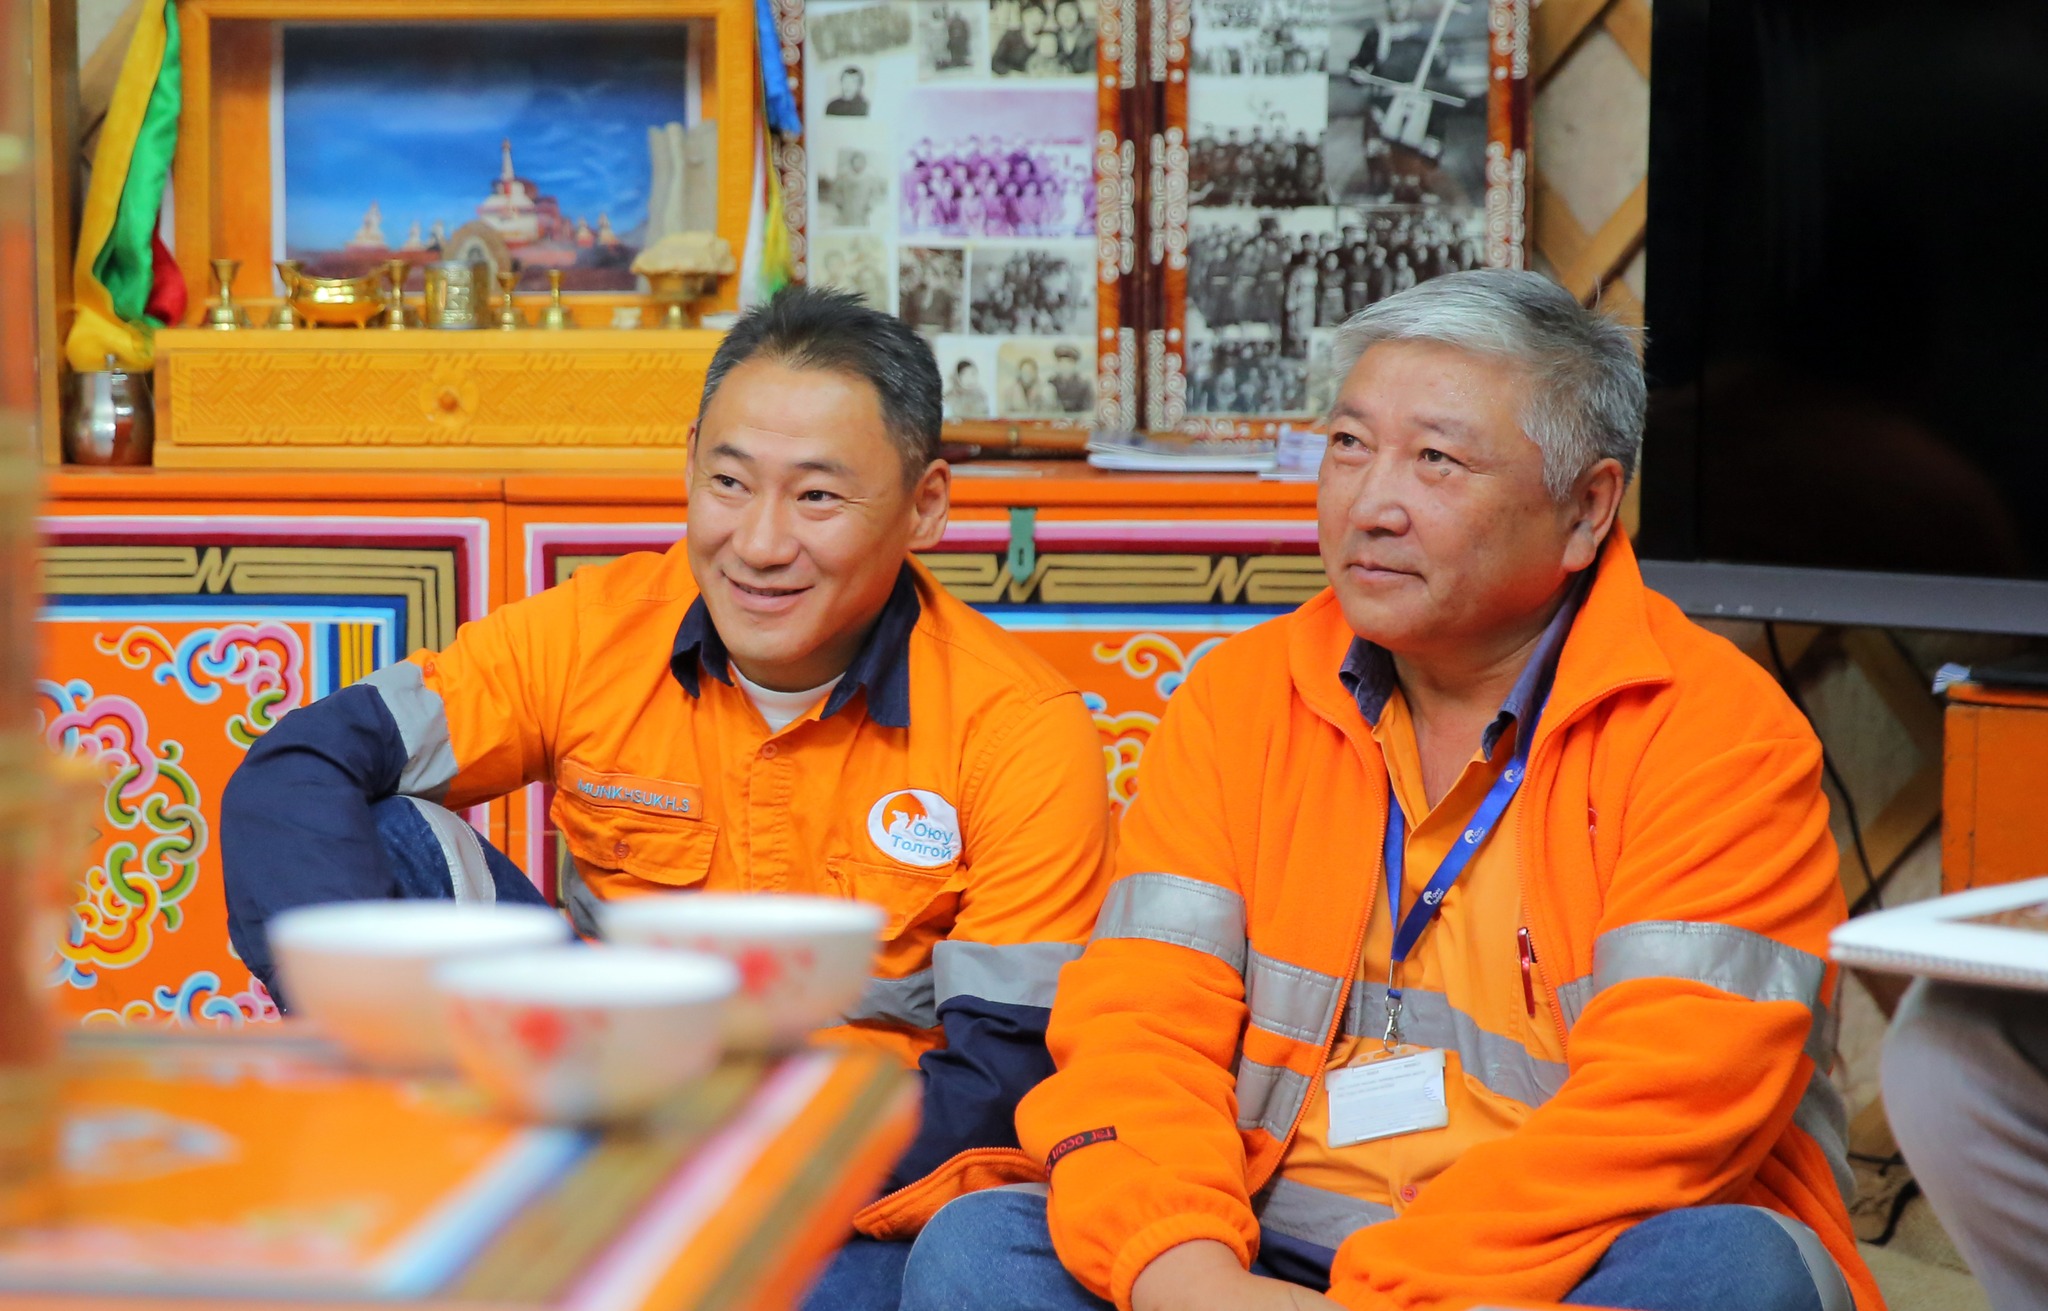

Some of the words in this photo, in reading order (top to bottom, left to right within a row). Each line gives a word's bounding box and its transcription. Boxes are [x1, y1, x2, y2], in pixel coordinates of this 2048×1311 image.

[577, 778, 690, 812] MUNKHSUKH.S
[891, 834, 952, 860] Толгой
[913, 823, 954, 846] Оюу
